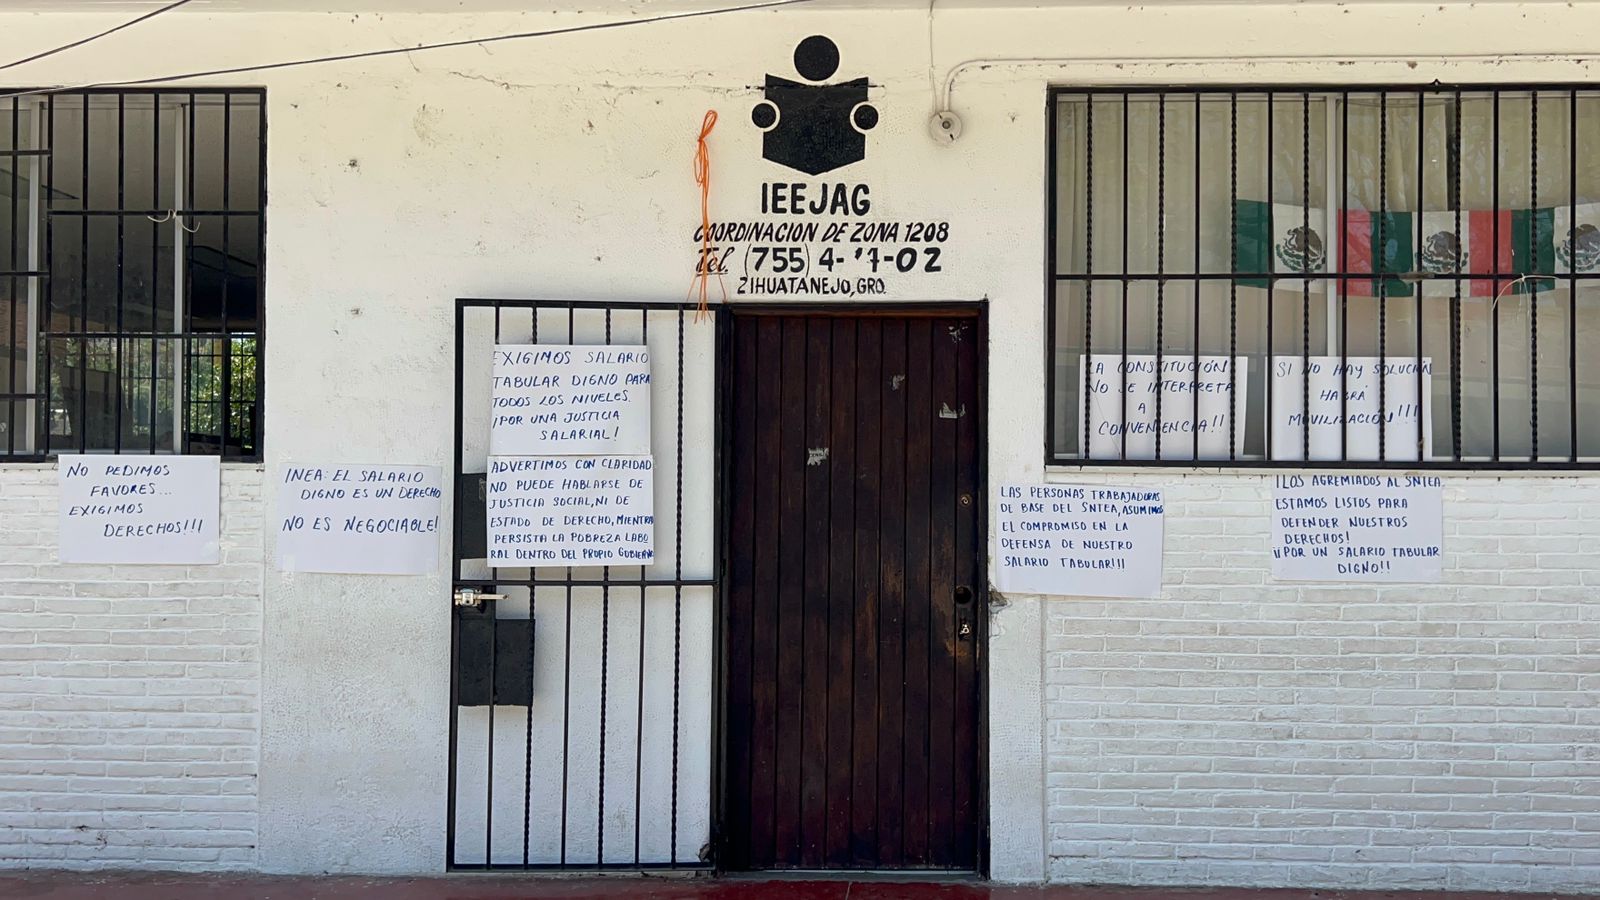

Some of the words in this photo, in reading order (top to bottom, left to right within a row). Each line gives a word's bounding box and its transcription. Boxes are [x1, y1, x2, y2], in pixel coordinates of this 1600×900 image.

[761, 183, 871, 216] IEEJAG
[693, 222, 819, 243] COORDINACION
[821, 222, 849, 243] DE
[850, 222, 900, 243] ZONA
[904, 222, 950, 243] 1208
[695, 246, 735, 275] Tel.
[744, 243, 811, 277] (755)
[584, 351, 649, 364] SALARIO
[1276, 361, 1292, 378] SI
[493, 375, 560, 389] TABULAR
[571, 373, 618, 386] DIGNO
[625, 373, 651, 386] PARA
[1320, 384, 1368, 401] HARÁ
[492, 396, 531, 408] TODOS
[539, 394, 564, 406] LOS
[1137, 402, 1147, 415] A
[530, 412, 557, 425] UNA
[563, 410, 621, 423] JUSTICIA
[539, 426, 620, 442] SALARIAL!
[66, 462, 89, 478] NO
[105, 464, 170, 477] PEDIMOS
[491, 459, 568, 474] ADVERTIMOS
[575, 458, 597, 470] CON
[601, 458, 652, 471] CLARIDAD
[332, 469, 351, 482] EL
[358, 470, 424, 483] SALARIO
[1312, 475, 1381, 487] AGREMIADOS
[1387, 476, 1400, 488] AL
[489, 480, 508, 493] NO
[516, 479, 555, 491] PUEDE
[562, 478, 621, 491] HABLARSE
[629, 478, 644, 489] DE
[300, 488, 345, 500] DIGNO
[352, 488, 369, 499] ES
[375, 487, 394, 499] UN
[398, 486, 441, 500] DERECHO
[1000, 486, 1022, 499] LAS
[1030, 486, 1085, 500] PERSONAS
[69, 503, 144, 516] EXIGIMOS
[489, 497, 545, 510] JUSTICIA
[615, 495, 631, 506] DE
[1000, 503, 1014, 514] DE
[1021, 502, 1045, 513] BASE
[1053, 502, 1073, 513] DEL
[1275, 497, 1328, 510] ESTAMOS
[1335, 497, 1371, 509] LISTOS
[1378, 498, 1408, 509] PARA
[103, 518, 203, 537] DERECHOS!!!
[282, 515, 305, 532] NO
[312, 516, 332, 532] ES
[343, 515, 439, 534] NEGOCIABLE!
[490, 516, 531, 528] ESTADO
[542, 517, 555, 527] DE
[1002, 521, 1016, 533] EL
[1020, 521, 1087, 532] COMPROMISO
[1092, 521, 1107, 531] EN
[1115, 521, 1129, 532] LA
[1281, 517, 1339, 528] DEFENDER
[1349, 516, 1408, 528] NUESTROS
[494, 533, 548, 544] PERSISTA
[552, 533, 565, 543] LA
[570, 532, 621, 544] POBREZA
[1001, 538, 1051, 550] DEFENSA
[1061, 539, 1075, 549] DE
[1083, 540, 1133, 550] NUESTRO
[1284, 531, 1350, 545] DERECHOS!
[490, 549, 510, 560] RAL
[516, 549, 556, 560] DENTRO
[561, 548, 578, 560] DEL
[583, 548, 614, 560] PROPIO
[1312, 546, 1328, 557] UN
[1338, 547, 1386, 557] SALARIO
[1392, 546, 1441, 557] TABULAR
[1004, 556, 1049, 568] SALARIO
[1337, 561, 1391, 575] DIGNO!!
